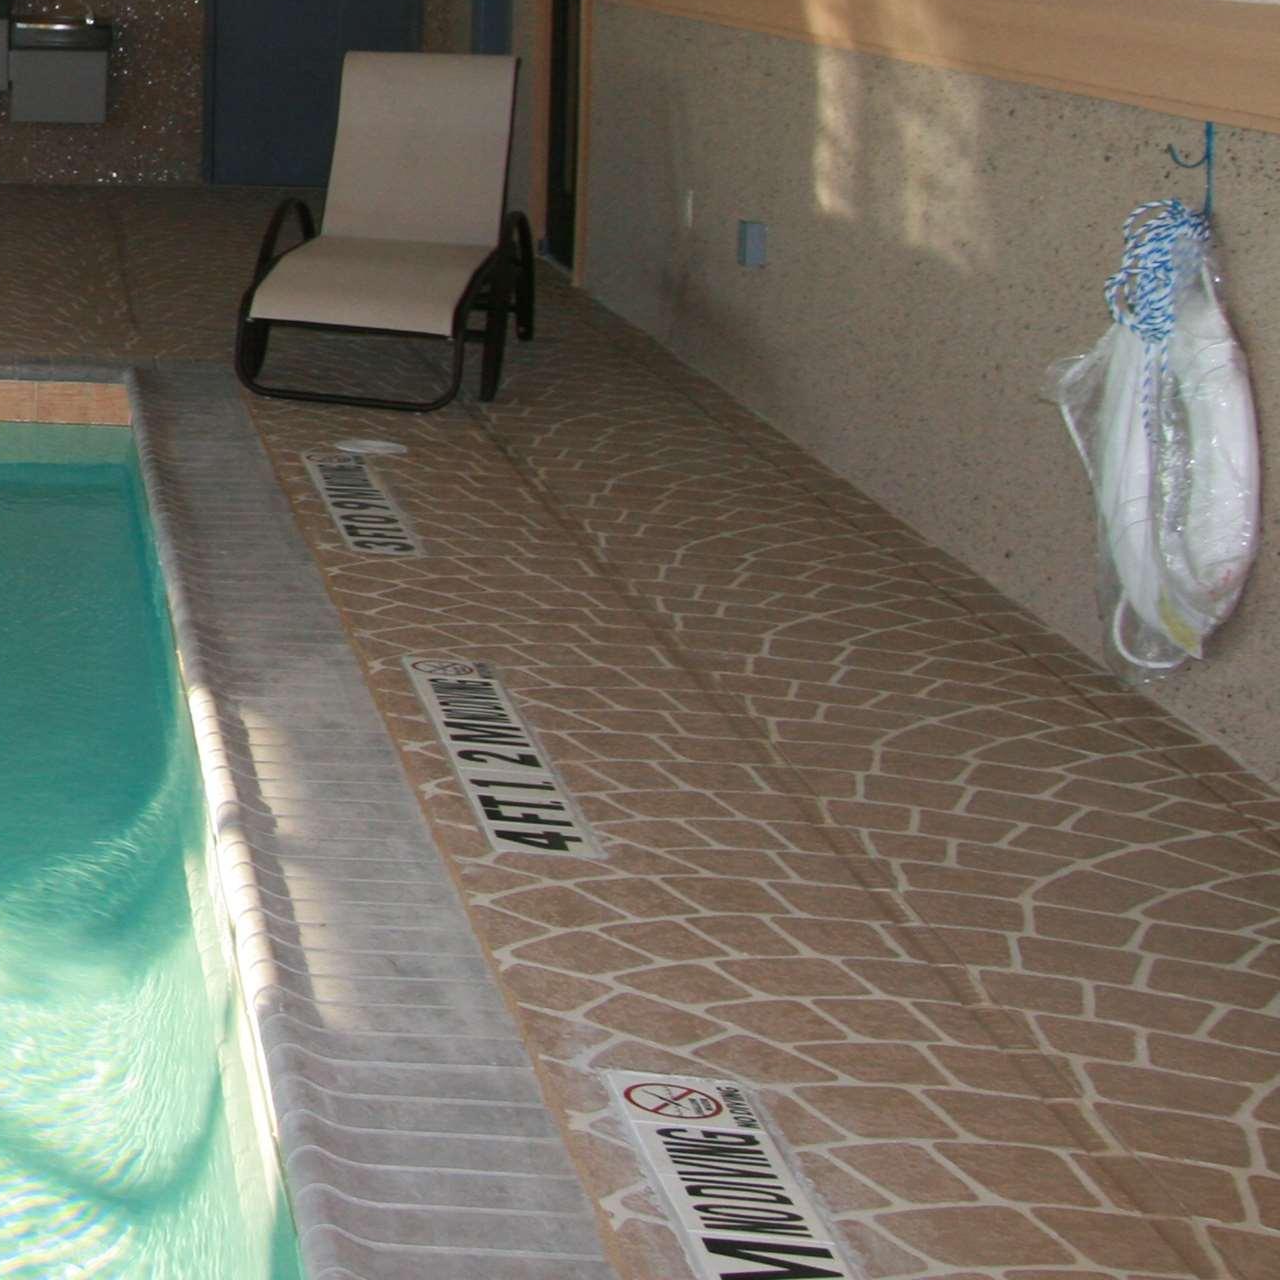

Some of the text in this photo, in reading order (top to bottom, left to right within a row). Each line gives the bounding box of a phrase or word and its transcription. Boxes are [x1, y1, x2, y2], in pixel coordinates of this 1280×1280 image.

[342, 524, 408, 540] FT
[353, 540, 415, 551] 3
[443, 721, 530, 747] M
[494, 829, 583, 851] 4
[656, 1128, 795, 1205] DIVING
[693, 1204, 813, 1237] NO
